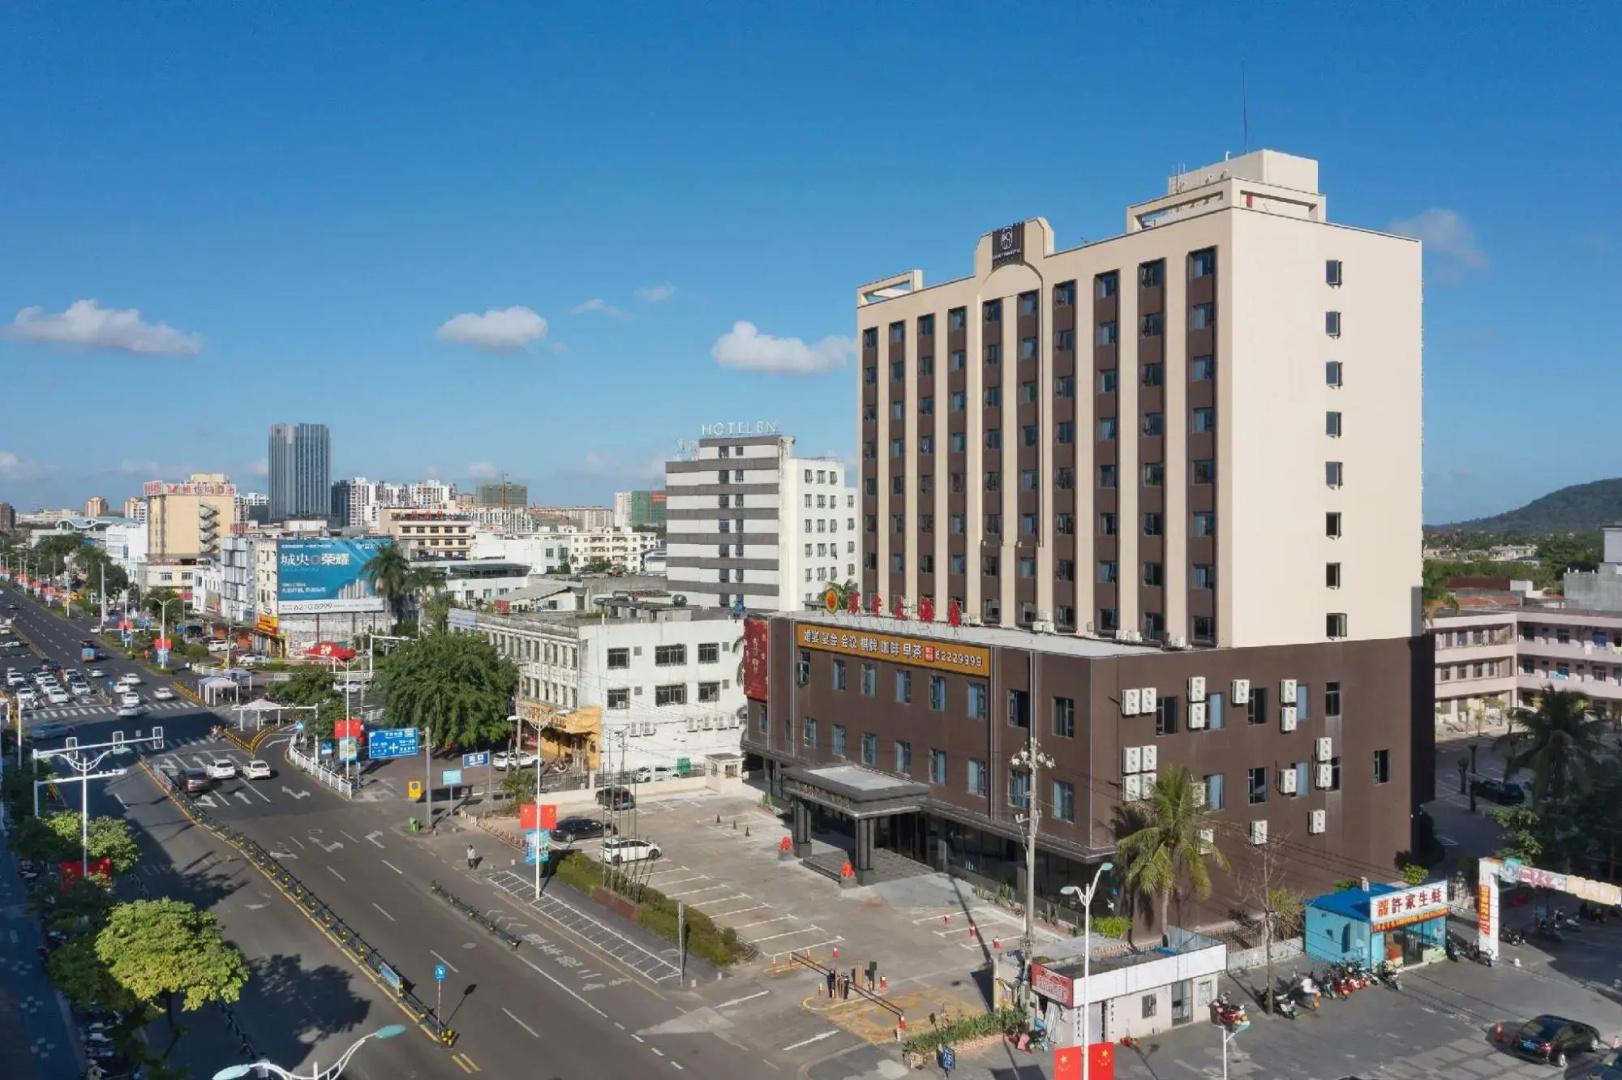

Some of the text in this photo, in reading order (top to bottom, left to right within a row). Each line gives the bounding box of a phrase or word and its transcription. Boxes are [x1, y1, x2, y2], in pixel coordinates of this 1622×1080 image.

[701, 421, 753, 435] HOTEL
[841, 634, 857, 649] 会议
[903, 643, 922, 659] 早茶
[935, 650, 983, 667] 62229999
